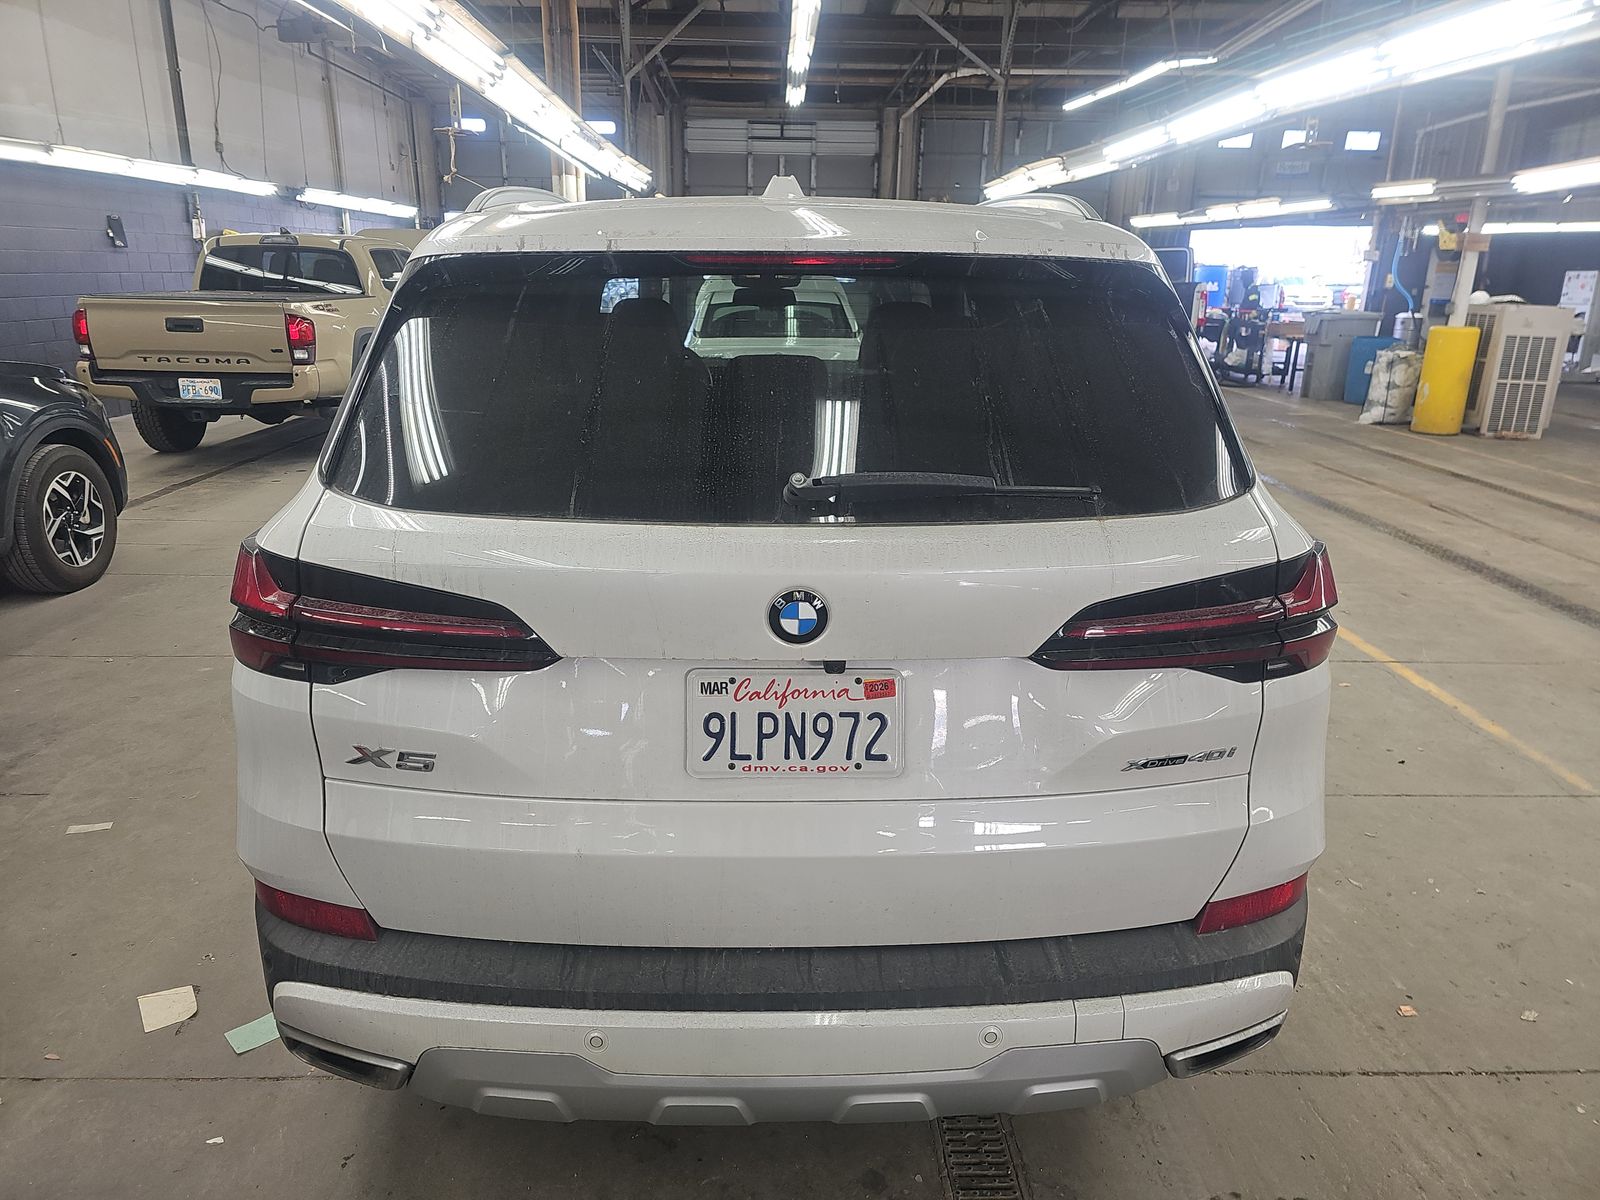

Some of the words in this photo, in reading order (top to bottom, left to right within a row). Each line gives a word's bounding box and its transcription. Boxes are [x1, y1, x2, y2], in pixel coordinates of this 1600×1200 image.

[137, 355, 251, 365] TACOMA
[773, 590, 825, 610] BMW
[700, 681, 729, 696] MAR
[732, 677, 864, 710] California
[869, 682, 890, 693] 2026
[702, 711, 890, 762] 9LPN972
[345, 743, 437, 773] X5
[741, 764, 851, 774] dmv.ca.gov
